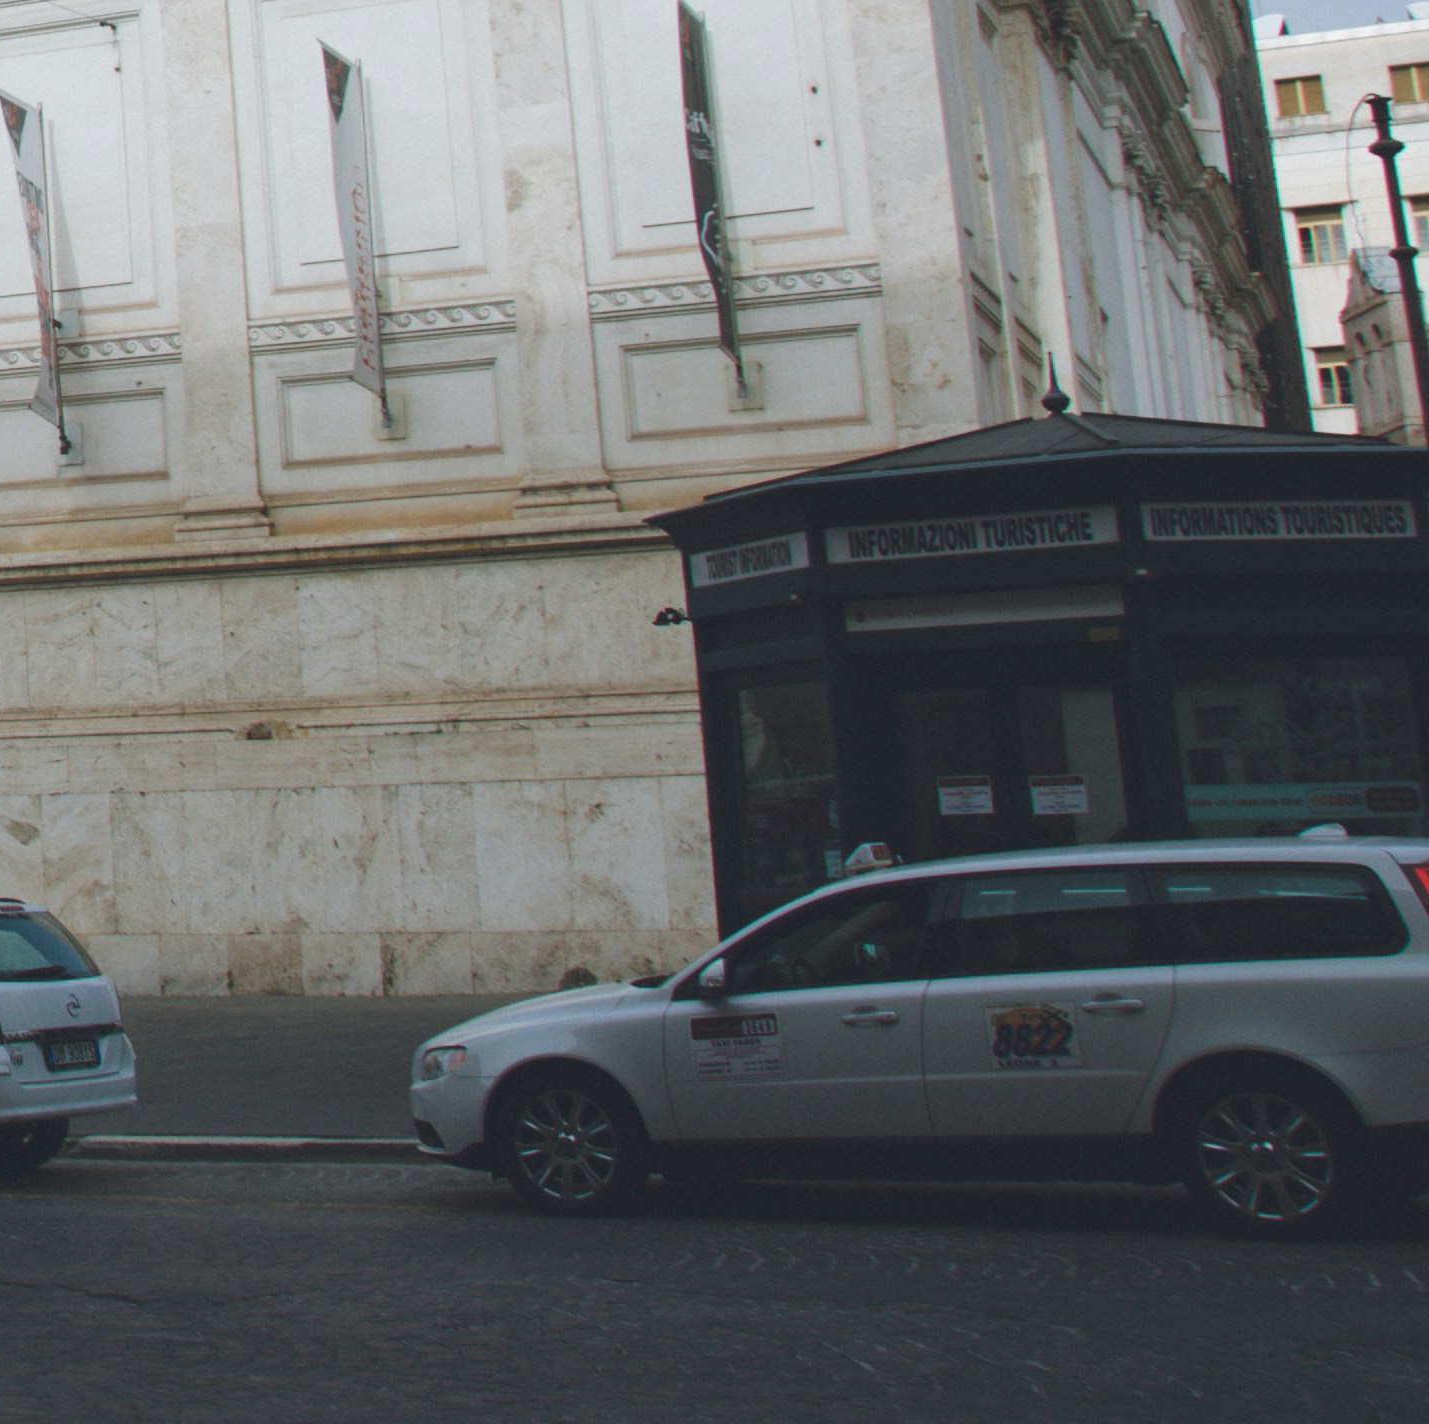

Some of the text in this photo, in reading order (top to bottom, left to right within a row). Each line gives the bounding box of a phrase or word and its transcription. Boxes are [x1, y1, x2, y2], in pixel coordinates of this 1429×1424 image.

[847, 511, 1094, 559] INFORMAZIONI TURISTICHE
[1150, 504, 1409, 537] INFORMATIONS TOURISTIQUES
[992, 1019, 1073, 1058] 8822
